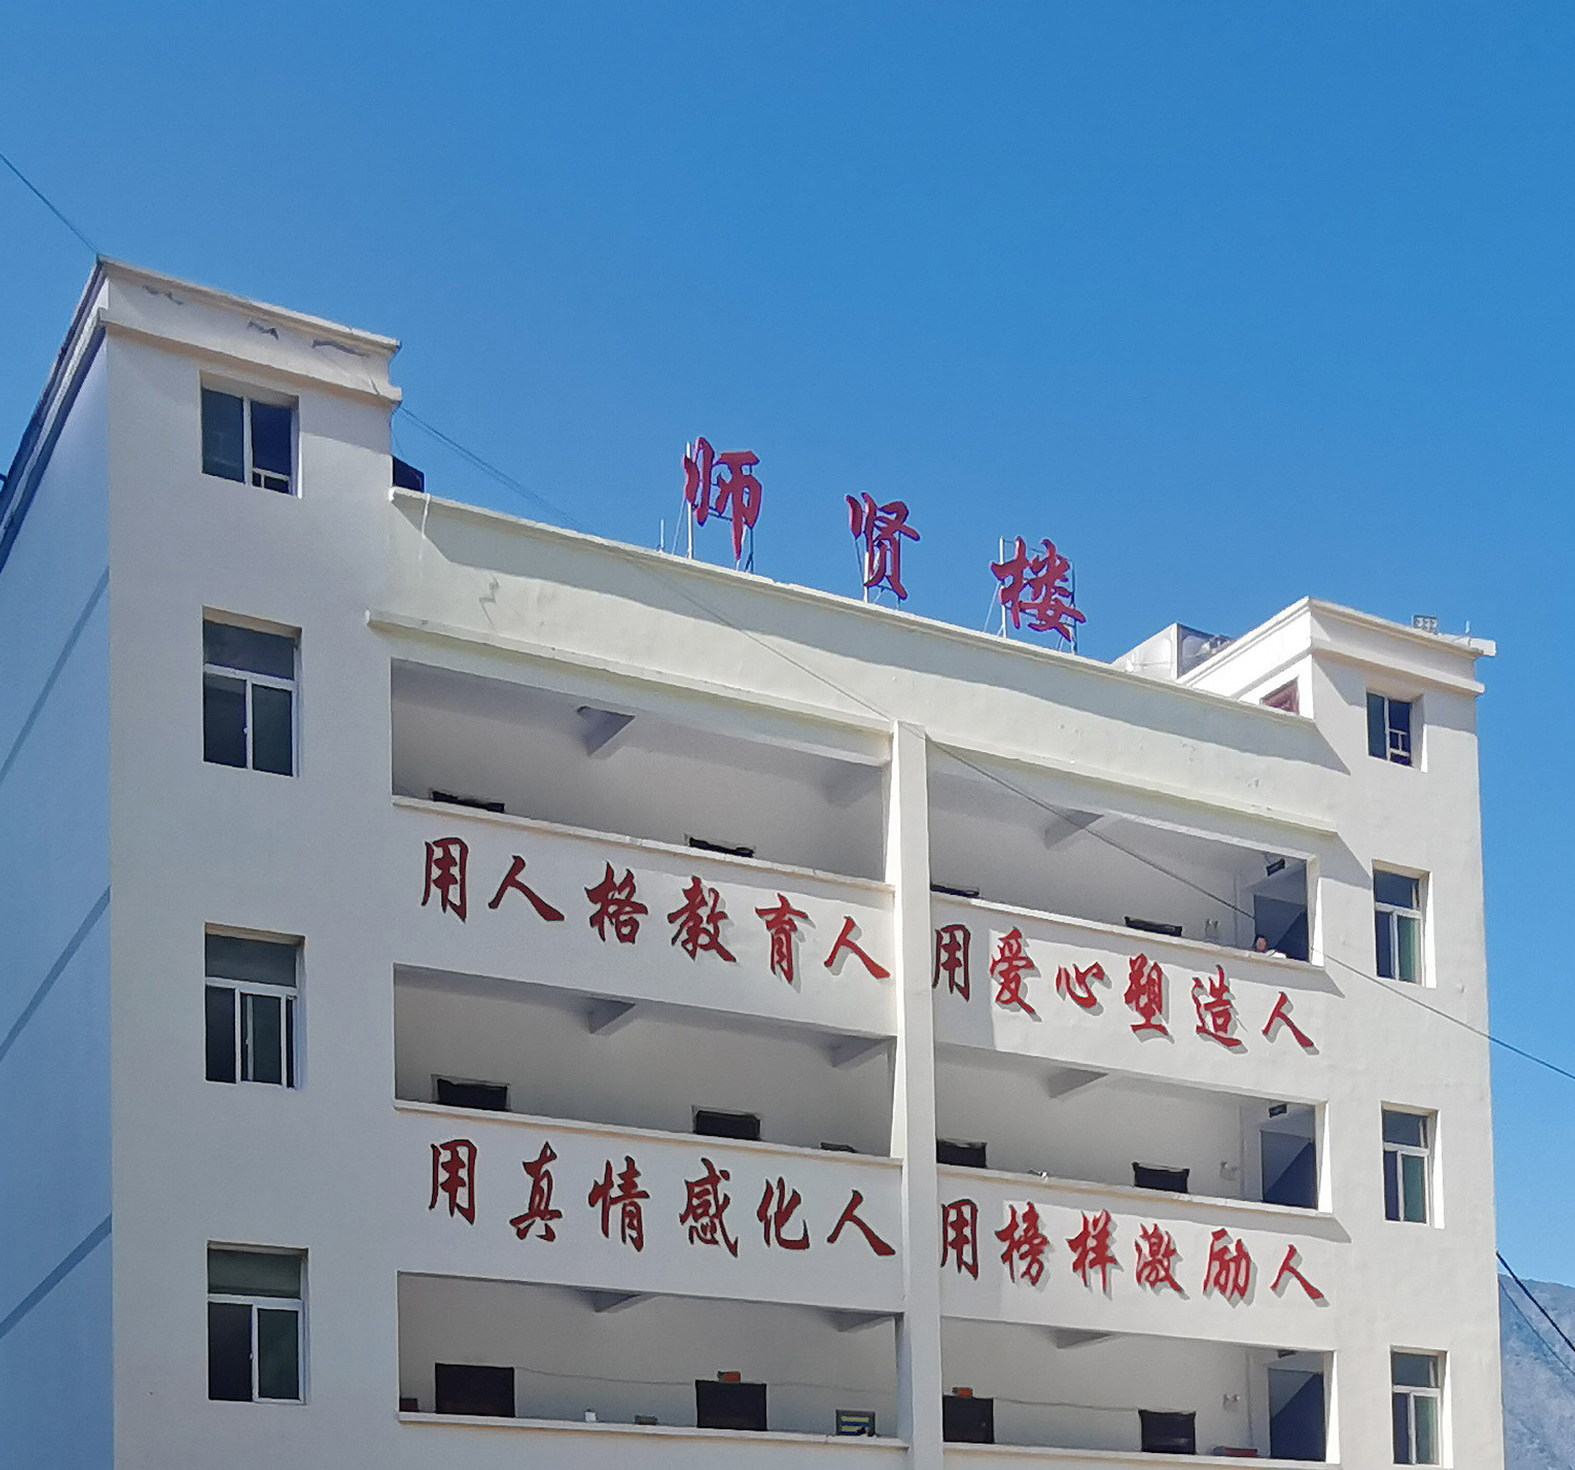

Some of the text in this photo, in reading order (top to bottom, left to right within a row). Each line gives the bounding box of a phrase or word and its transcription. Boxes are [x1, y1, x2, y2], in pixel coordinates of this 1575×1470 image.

[682, 437, 1087, 641] 师贤楼
[421, 837, 891, 984] 用人格教育人
[931, 923, 1316, 1055] 用爱心塑造人
[428, 1139, 895, 1258] 用真情感化人
[939, 1199, 1328, 1304] 用榜样激励人
